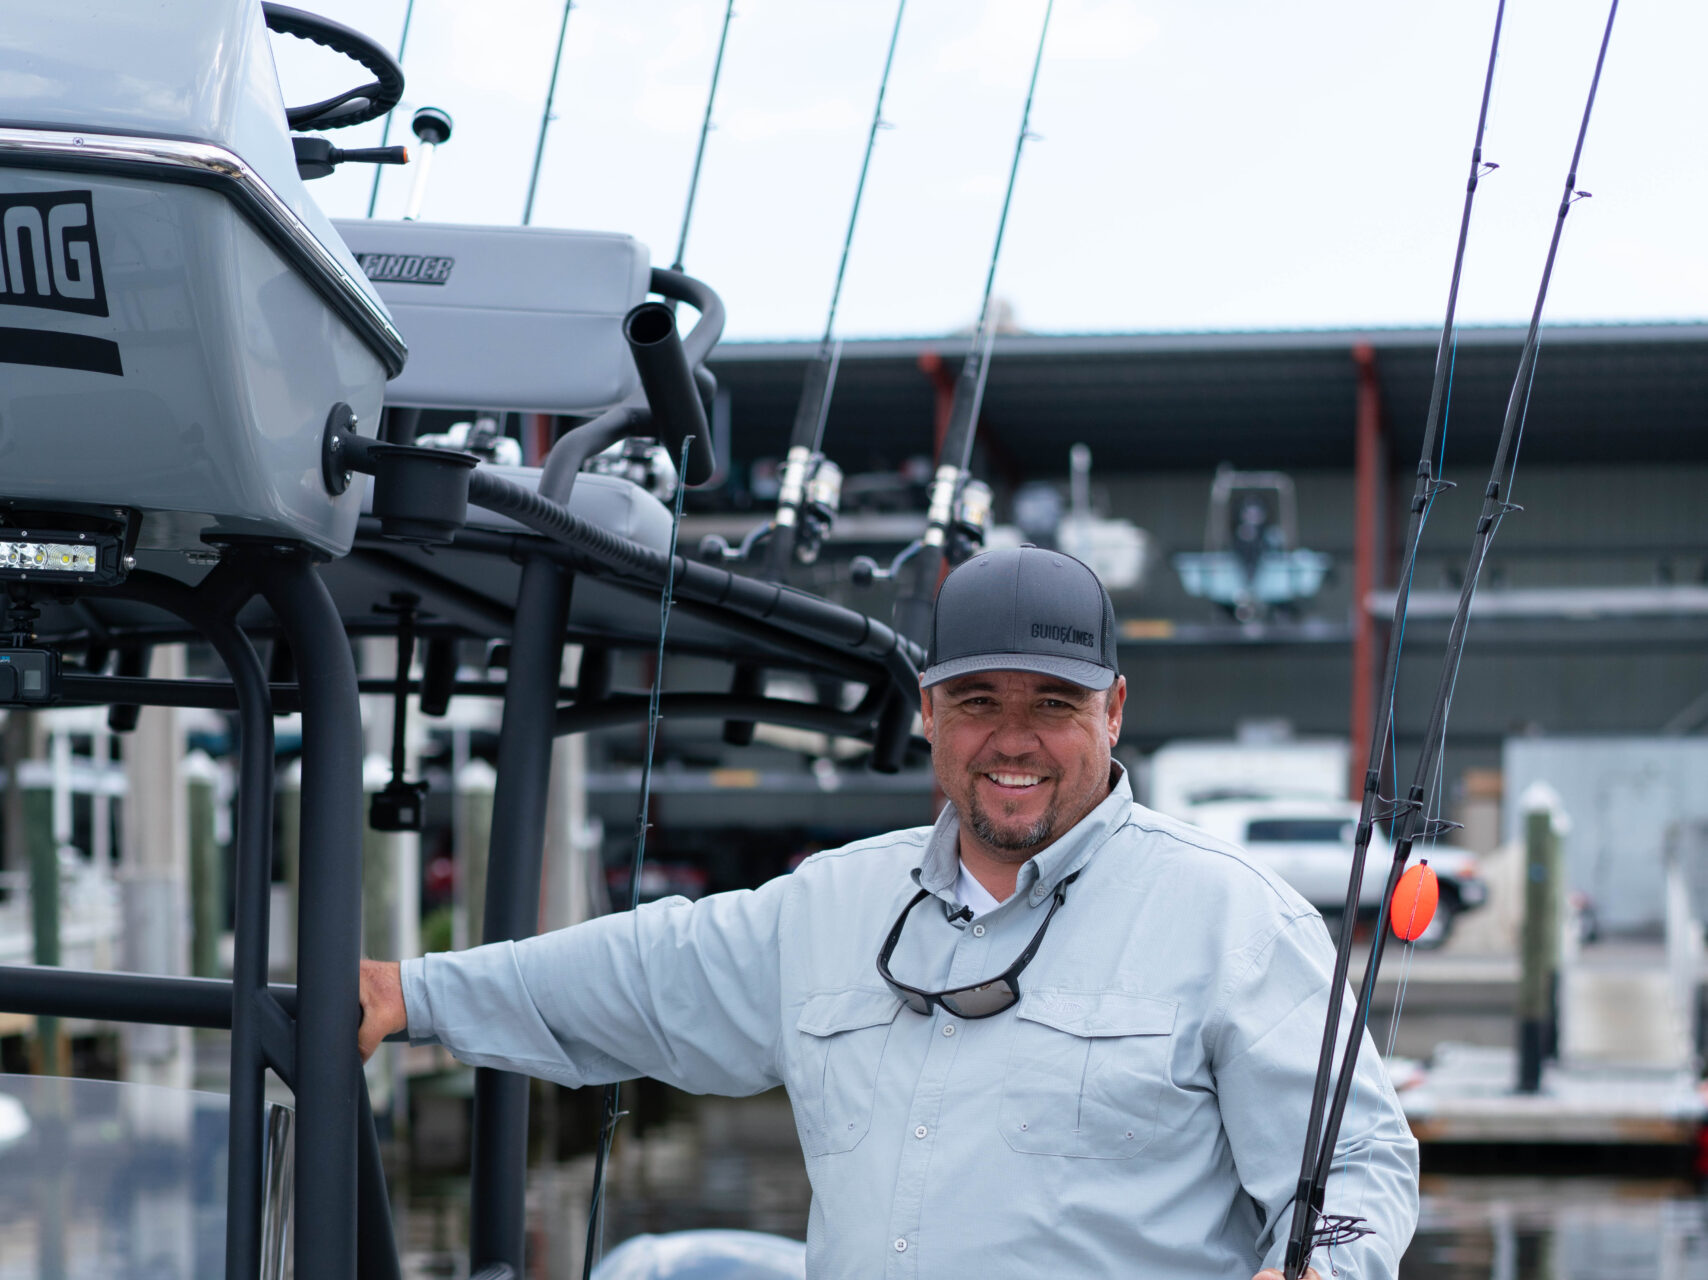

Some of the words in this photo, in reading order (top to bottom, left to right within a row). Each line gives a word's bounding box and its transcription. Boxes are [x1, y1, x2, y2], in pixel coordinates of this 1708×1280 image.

[0, 202, 96, 299] NG
[358, 253, 454, 281] FINDER
[1031, 623, 1095, 648] GUIDELINES
